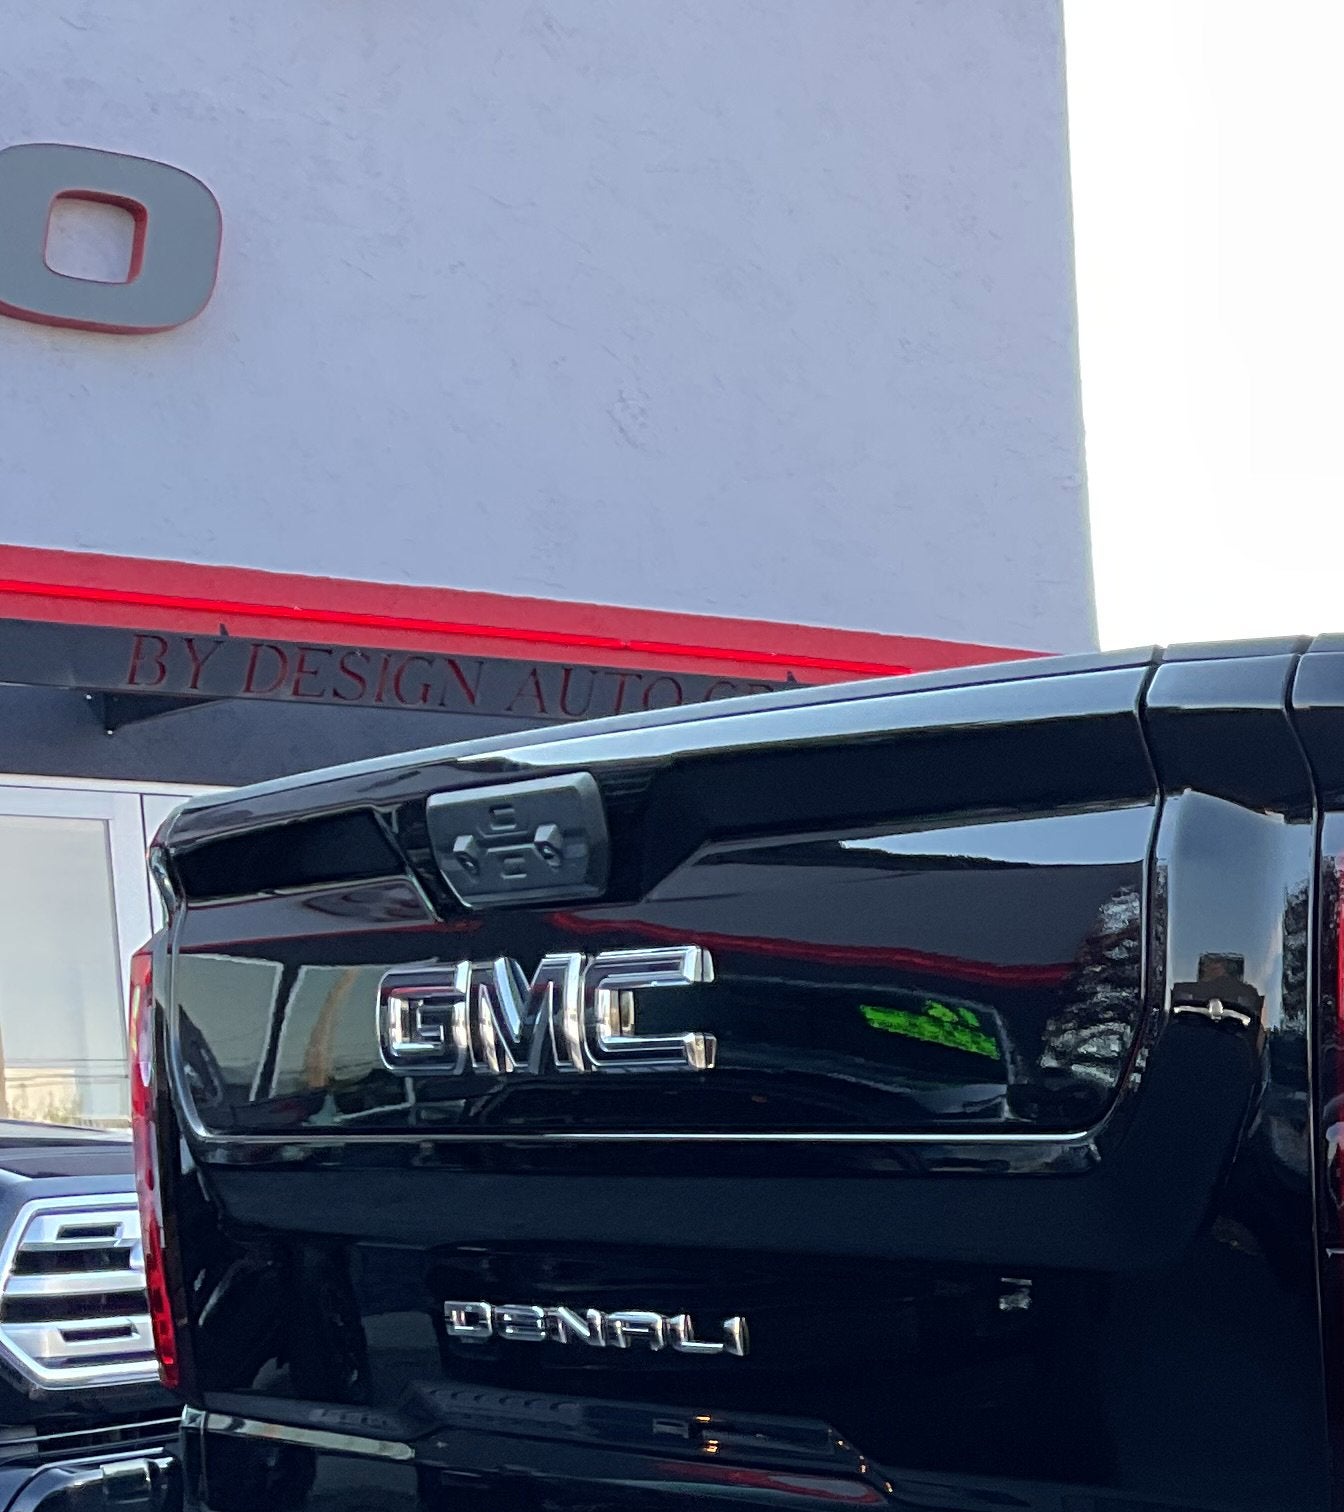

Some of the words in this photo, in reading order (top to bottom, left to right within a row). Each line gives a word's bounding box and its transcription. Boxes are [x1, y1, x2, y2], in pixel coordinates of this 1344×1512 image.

[127, 633, 225, 690] BY
[241, 642, 485, 706] DESIGN
[505, 667, 683, 716] AUTO
[375, 945, 717, 1076] GMC
[444, 1300, 748, 1356] DENALI
